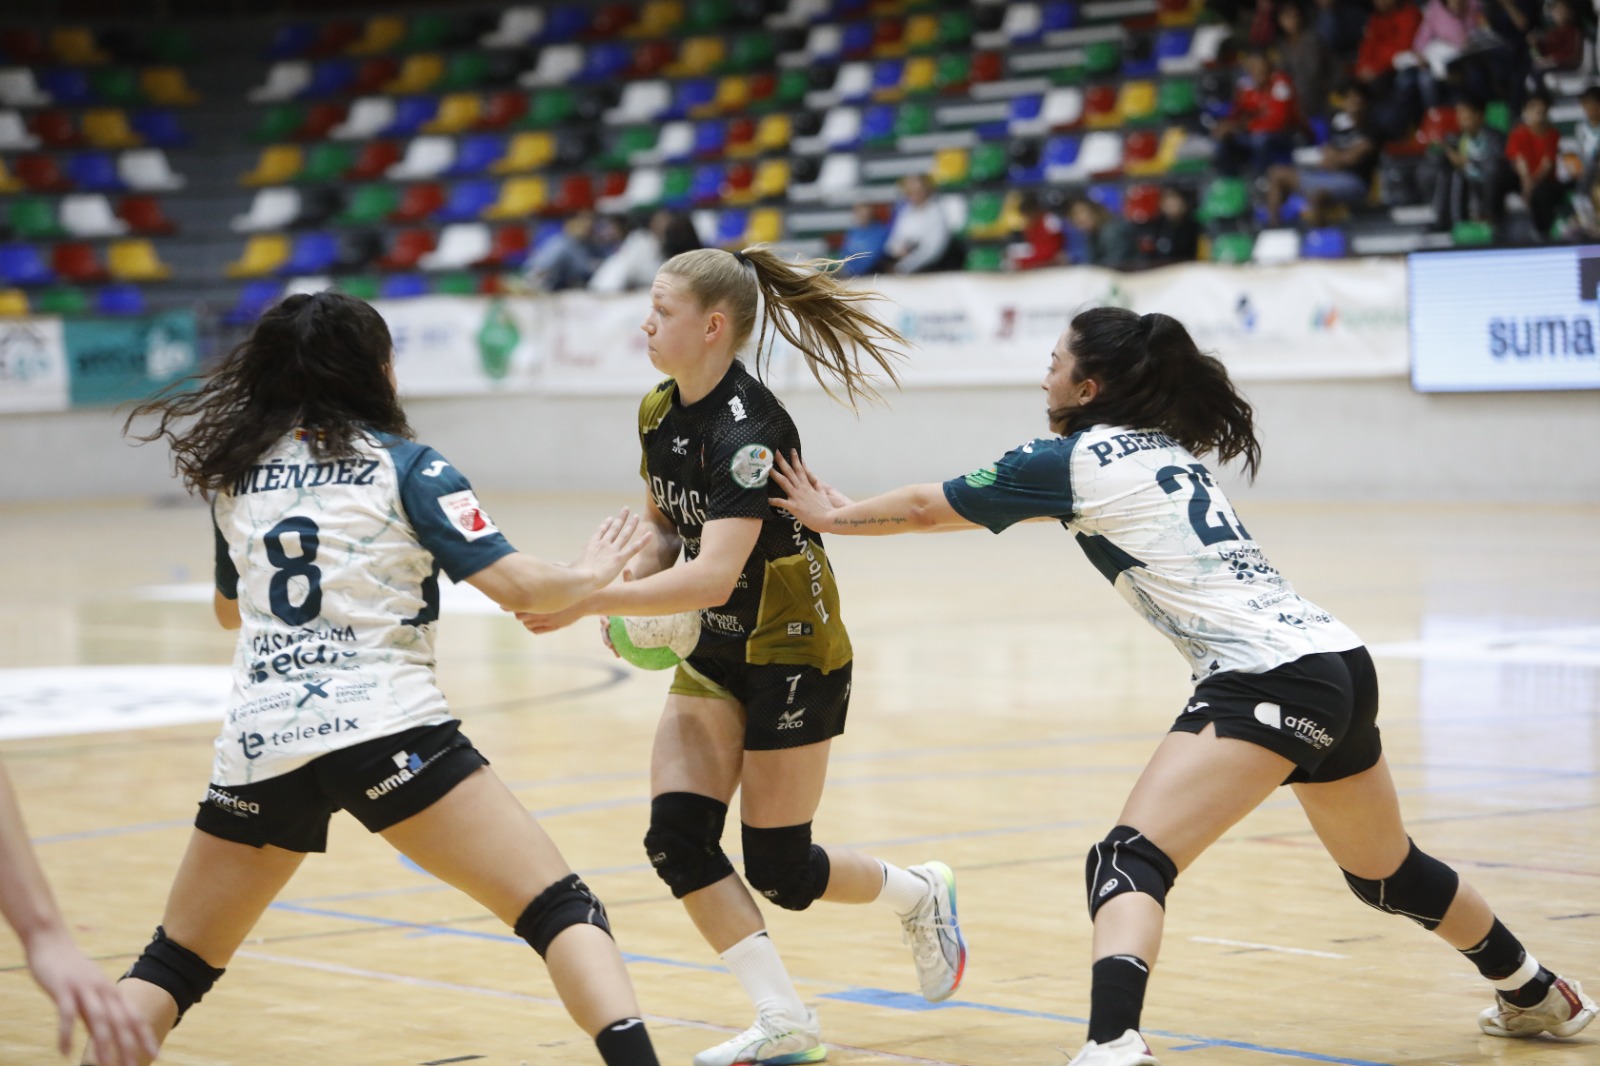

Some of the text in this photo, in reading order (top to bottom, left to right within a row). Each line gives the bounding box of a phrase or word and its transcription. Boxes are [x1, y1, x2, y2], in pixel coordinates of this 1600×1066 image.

[1488, 317, 1596, 359] suma
[262, 515, 323, 627] 8
[717, 620, 746, 634] TECLA
[272, 717, 360, 747] teleelx
[776, 720, 804, 731] ZICO
[1283, 715, 1335, 748] affidea
[365, 768, 415, 801] suma
